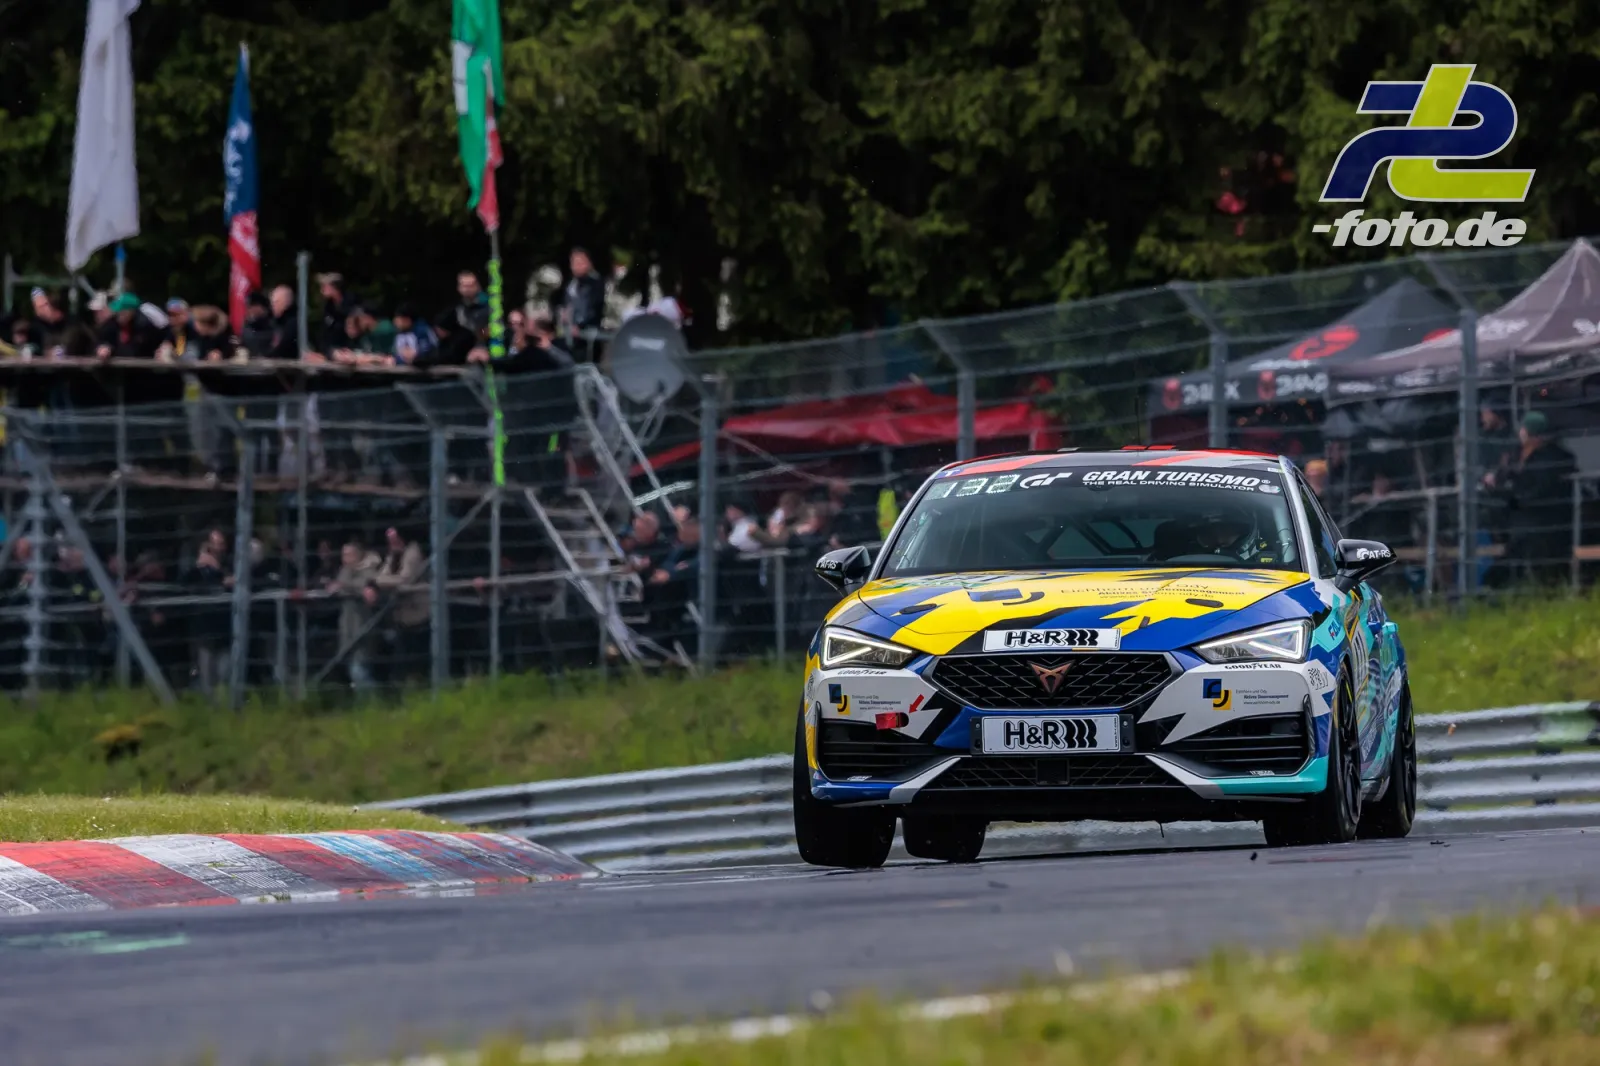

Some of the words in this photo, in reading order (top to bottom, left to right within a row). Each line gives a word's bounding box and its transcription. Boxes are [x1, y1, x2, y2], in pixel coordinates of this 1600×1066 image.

[1082, 471, 1151, 481] GRAN
[1152, 470, 1261, 487] TURISMO
[1188, 482, 1255, 492] SIMULATOR
[1004, 630, 1066, 648] H&R
[1224, 662, 1282, 670] GOODYEAR
[1004, 720, 1066, 749] H&R
